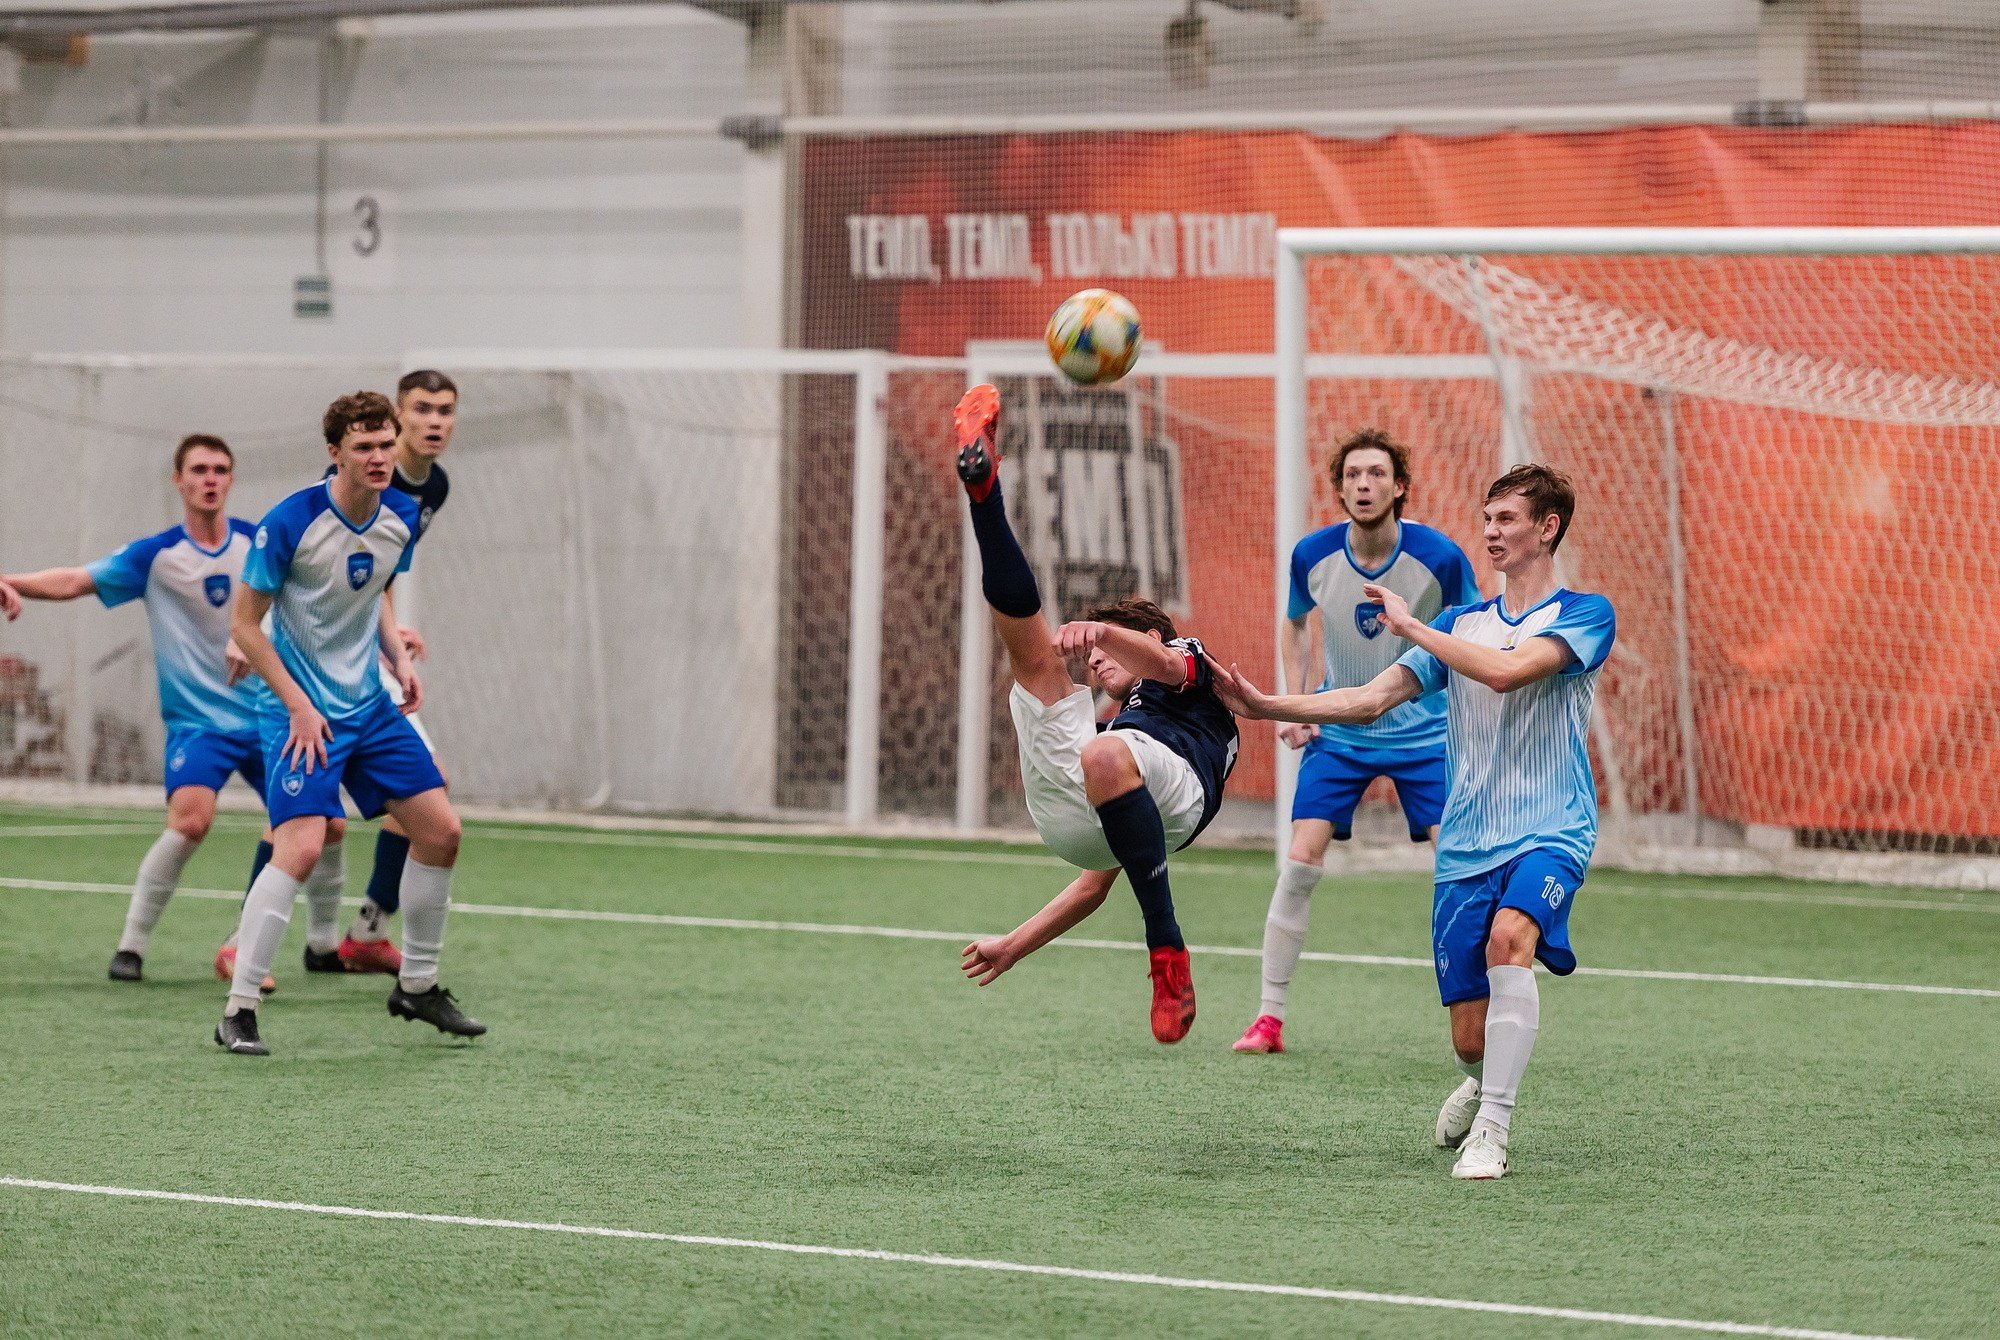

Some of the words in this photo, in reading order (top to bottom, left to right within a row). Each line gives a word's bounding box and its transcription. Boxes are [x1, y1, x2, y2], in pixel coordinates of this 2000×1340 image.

[353, 196, 381, 257] 3
[846, 214, 942, 286] ТЕМП,
[944, 213, 1042, 286] ТЕМП,
[1046, 212, 1176, 277] ТОЛЬКО
[1541, 875, 1565, 910] 18
